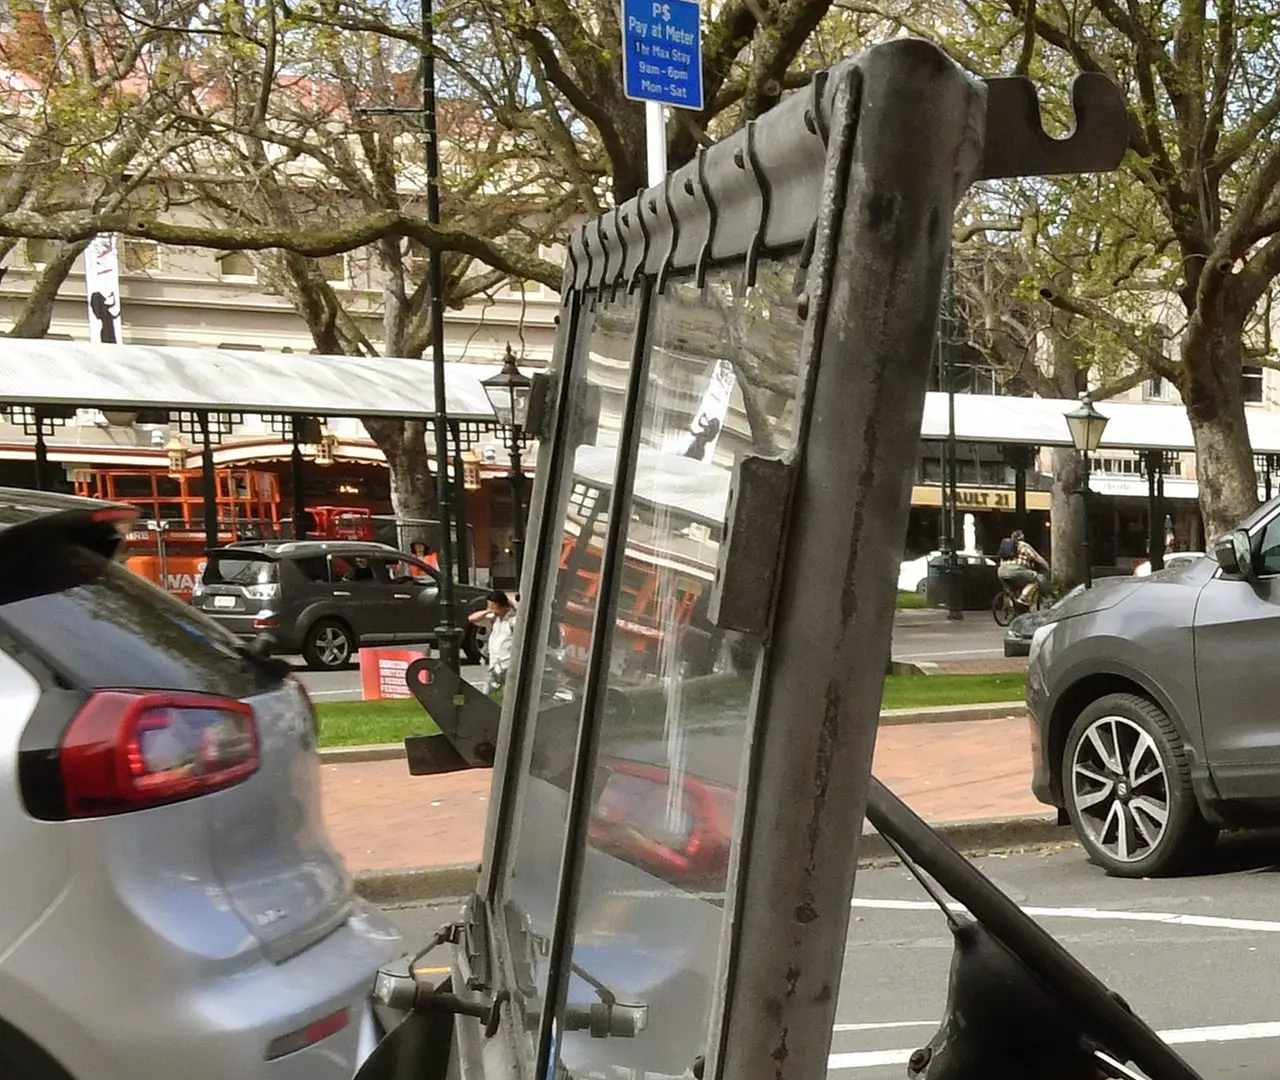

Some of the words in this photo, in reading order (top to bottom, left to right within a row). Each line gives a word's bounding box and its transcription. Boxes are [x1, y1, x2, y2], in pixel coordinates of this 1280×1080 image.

[628, 16, 648, 38] Pay
[652, 23, 662, 39] at
[666, 24, 694, 45] Meter
[652, 45, 670, 59] Max
[671, 49, 691, 65] Stay
[641, 79, 662, 93] Mon
[669, 83, 688, 98] Sat
[995, 493, 1009, 506] 21
